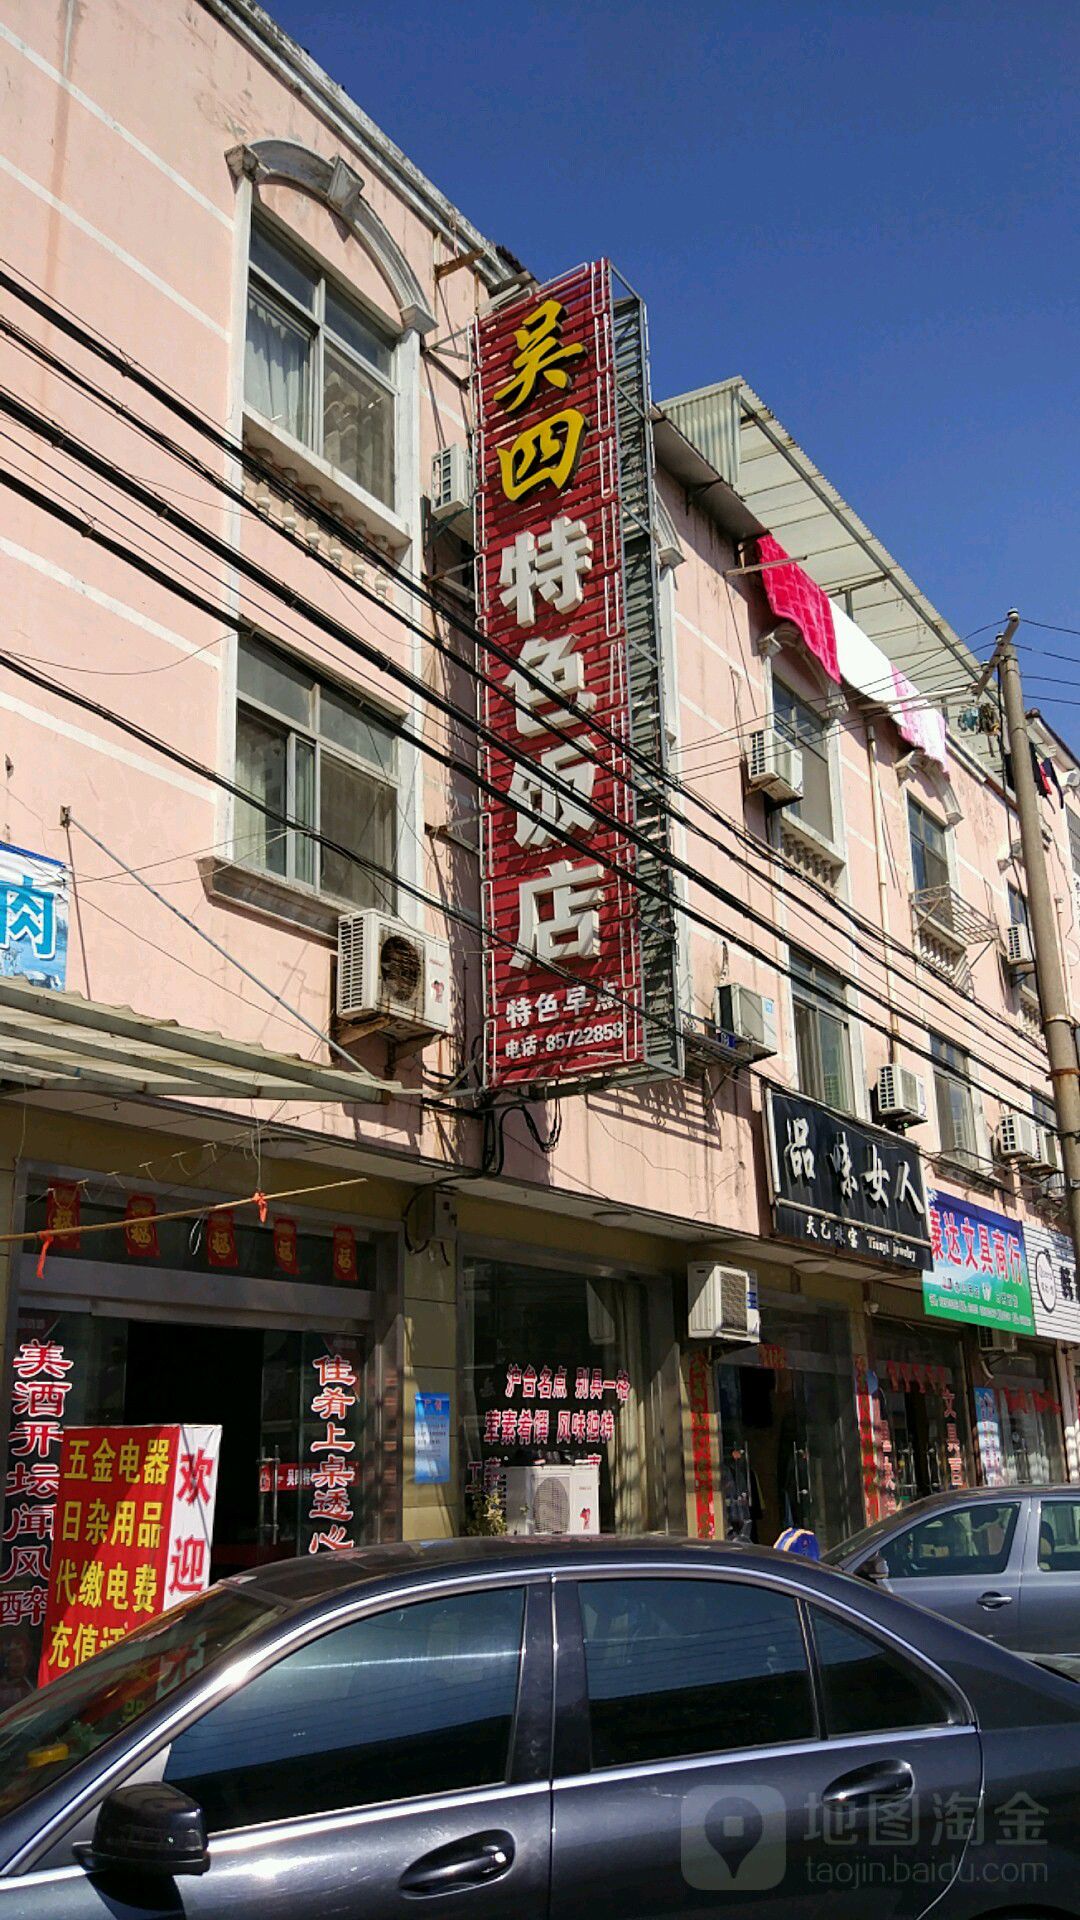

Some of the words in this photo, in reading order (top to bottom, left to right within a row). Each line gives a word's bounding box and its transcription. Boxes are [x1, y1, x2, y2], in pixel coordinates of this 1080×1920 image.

[505, 980, 624, 1028] 特色早点
[785, 1116, 925, 1214] 品味女人
[0, 1338, 74, 1627] 美酒开坛闻风醉
[63, 1438, 172, 1486] 五金电器
[61, 1498, 164, 1549] 日杂用品
[168, 1447, 215, 1597] 欢迎
[55, 1559, 158, 1614] 代缴电费
